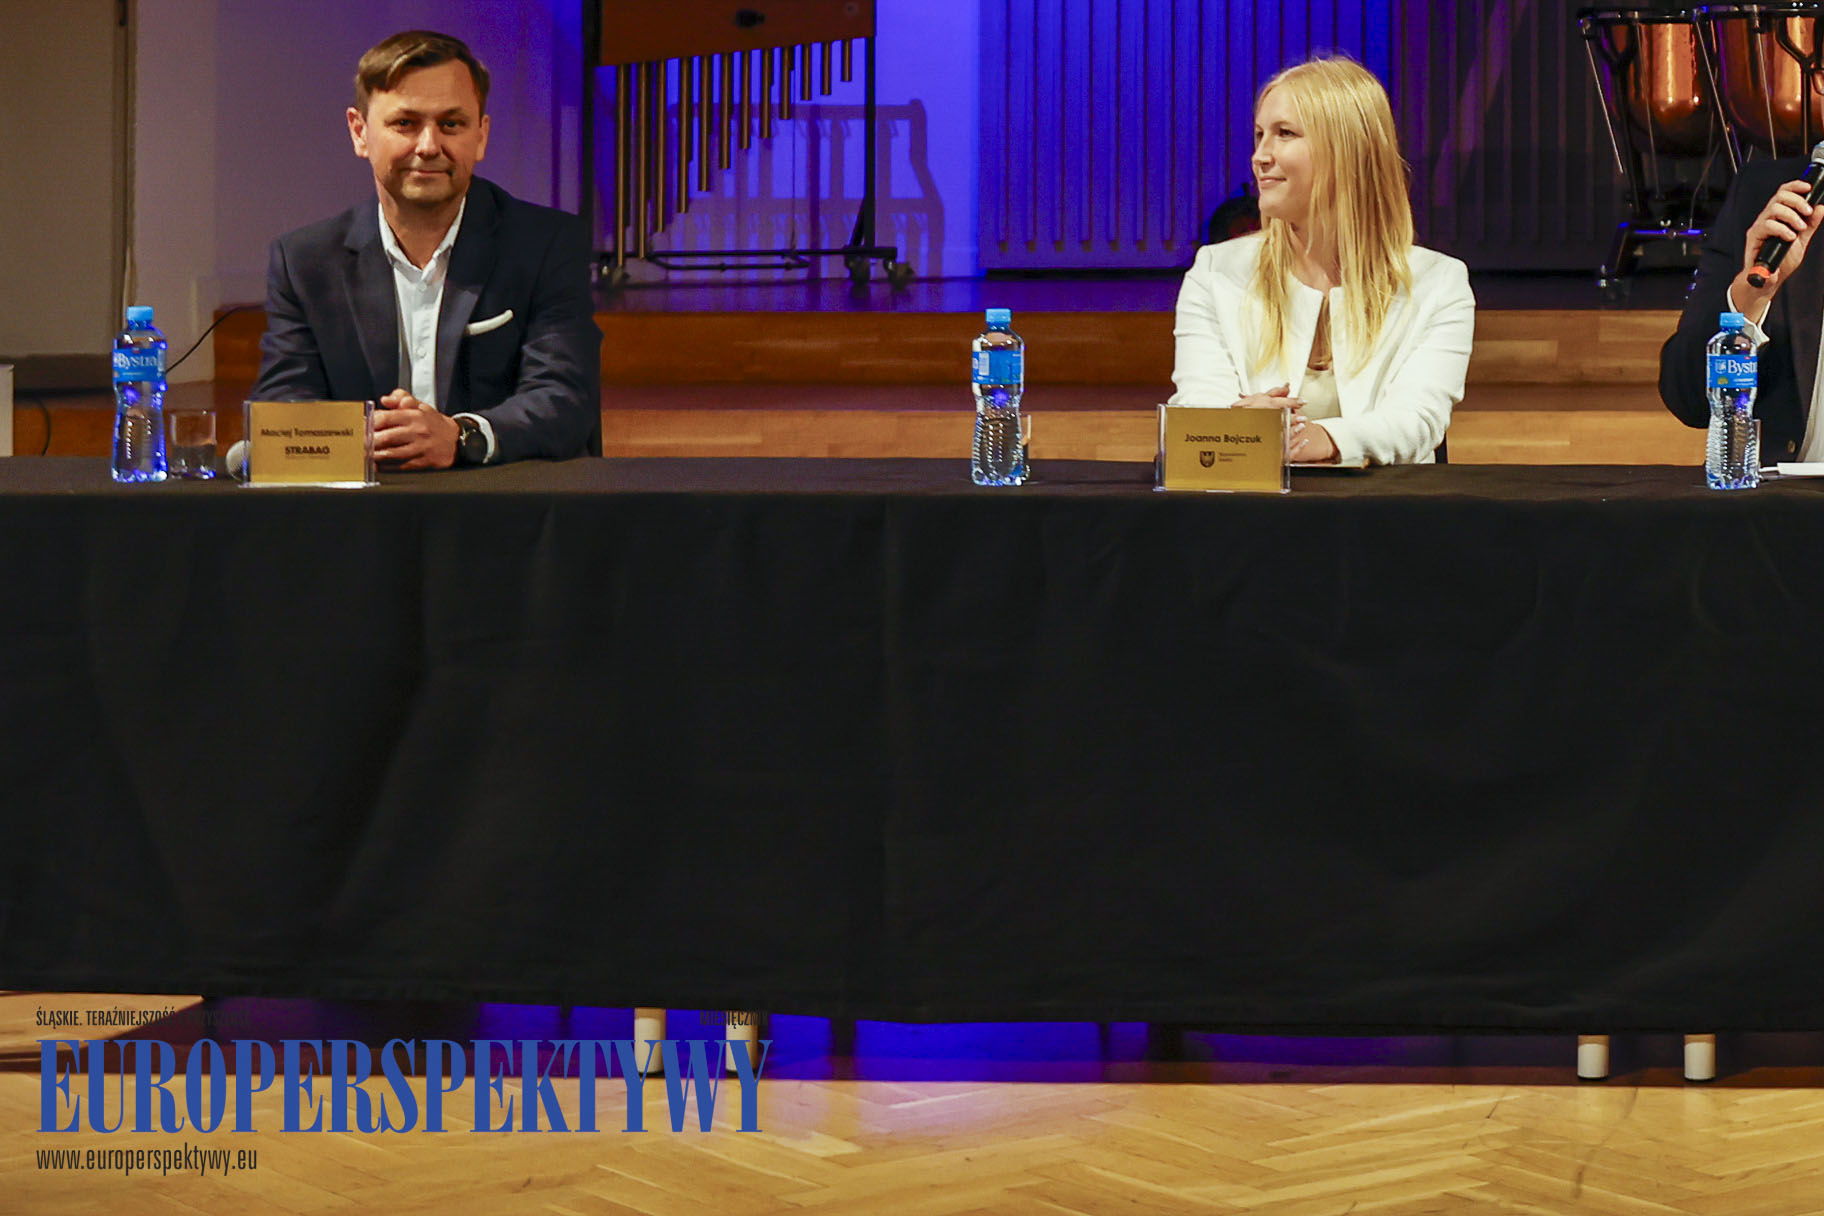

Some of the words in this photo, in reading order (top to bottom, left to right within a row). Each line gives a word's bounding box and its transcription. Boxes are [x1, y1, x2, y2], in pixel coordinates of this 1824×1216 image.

[1727, 359, 1758, 377] Bystr
[1184, 433, 1222, 444] Joanna
[1223, 433, 1263, 446] Bojczuk
